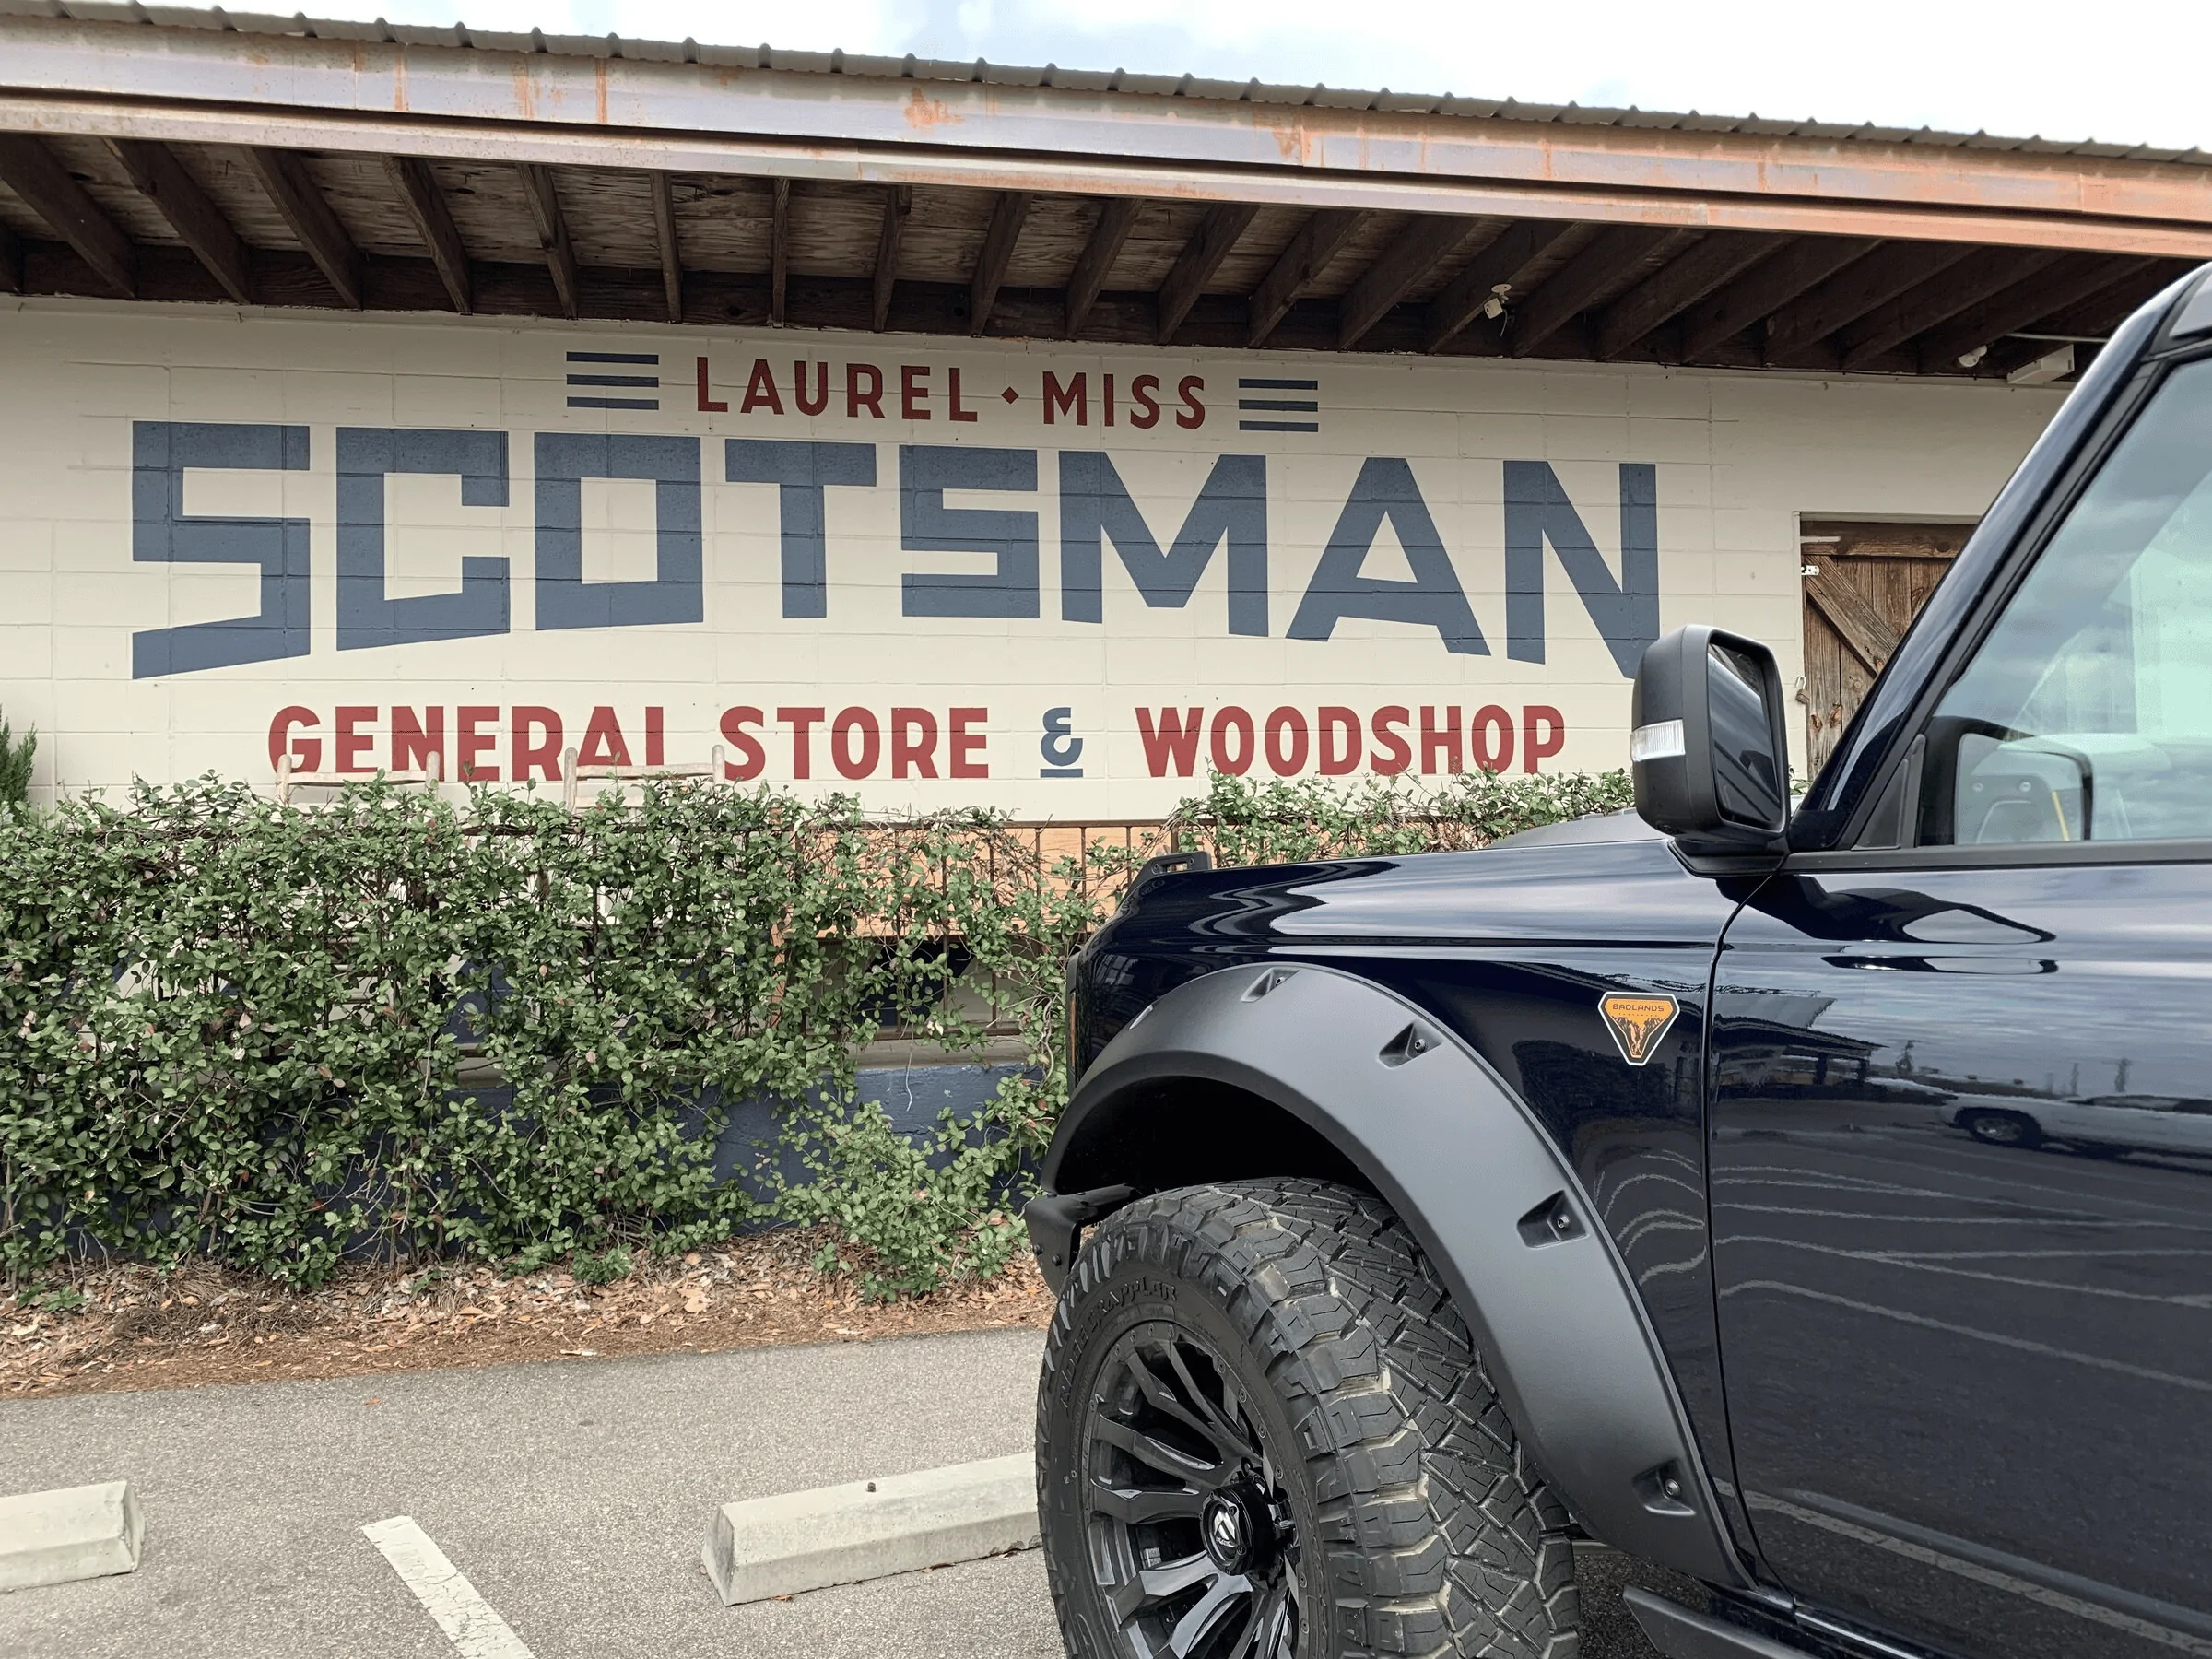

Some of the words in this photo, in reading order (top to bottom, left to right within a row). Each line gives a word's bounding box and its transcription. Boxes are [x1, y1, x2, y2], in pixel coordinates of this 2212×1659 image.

[697, 356, 978, 423] LAUREL
[1042, 371, 1206, 430] MISS
[132, 420, 1661, 679] SCOTSMAN
[268, 705, 664, 782] GENERAL
[719, 705, 989, 781] STORE
[1040, 707, 1083, 778] &
[1135, 705, 1566, 778] WOODSHOP
[1612, 1003, 1665, 1012] BADLANDS
